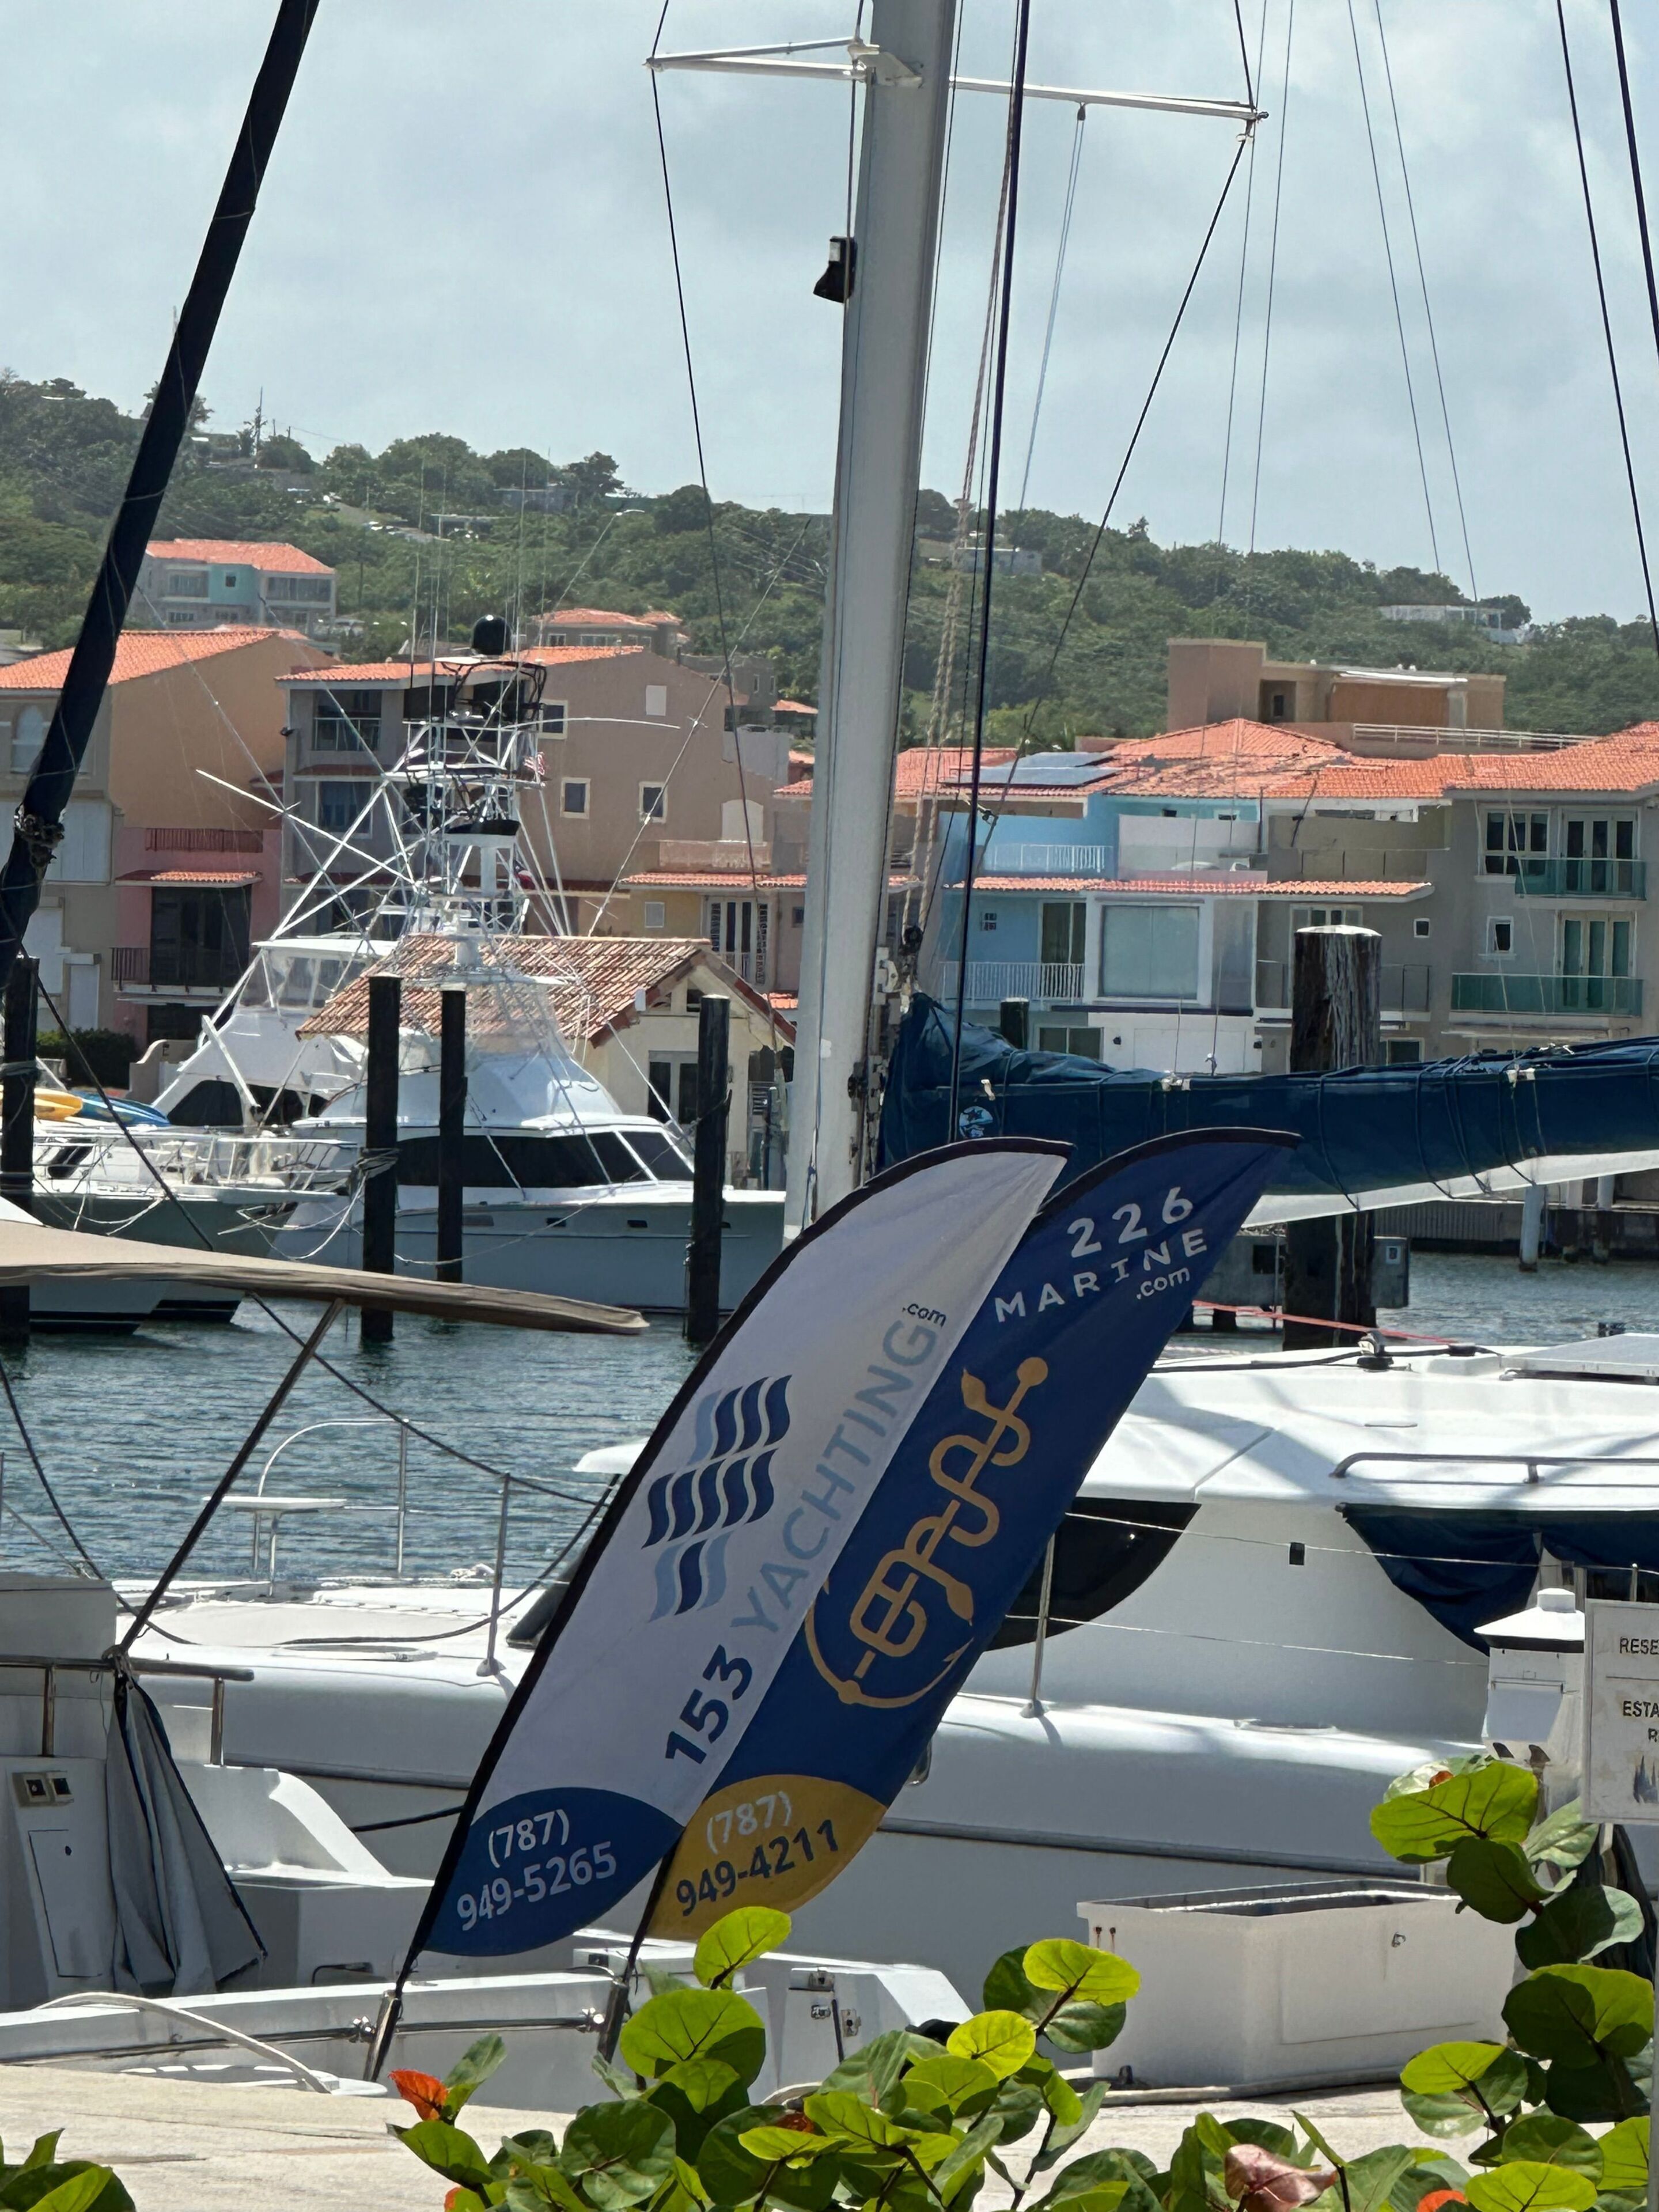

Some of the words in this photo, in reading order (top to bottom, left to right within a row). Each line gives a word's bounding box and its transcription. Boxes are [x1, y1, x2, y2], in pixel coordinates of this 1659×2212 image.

[1066, 1186, 1194, 1258] 226
[994, 1228, 1207, 1323] MARINE
[1136, 1267, 1191, 1300] .com
[902, 1303, 947, 1328] .com
[665, 1644, 753, 1764] 153
[729, 1319, 938, 1633] YACHTING
[488, 1809, 570, 1868] (787)
[706, 1790, 792, 1855] (787)
[456, 1840, 617, 1931] 949-5265
[676, 1819, 839, 1917] 949-4211
